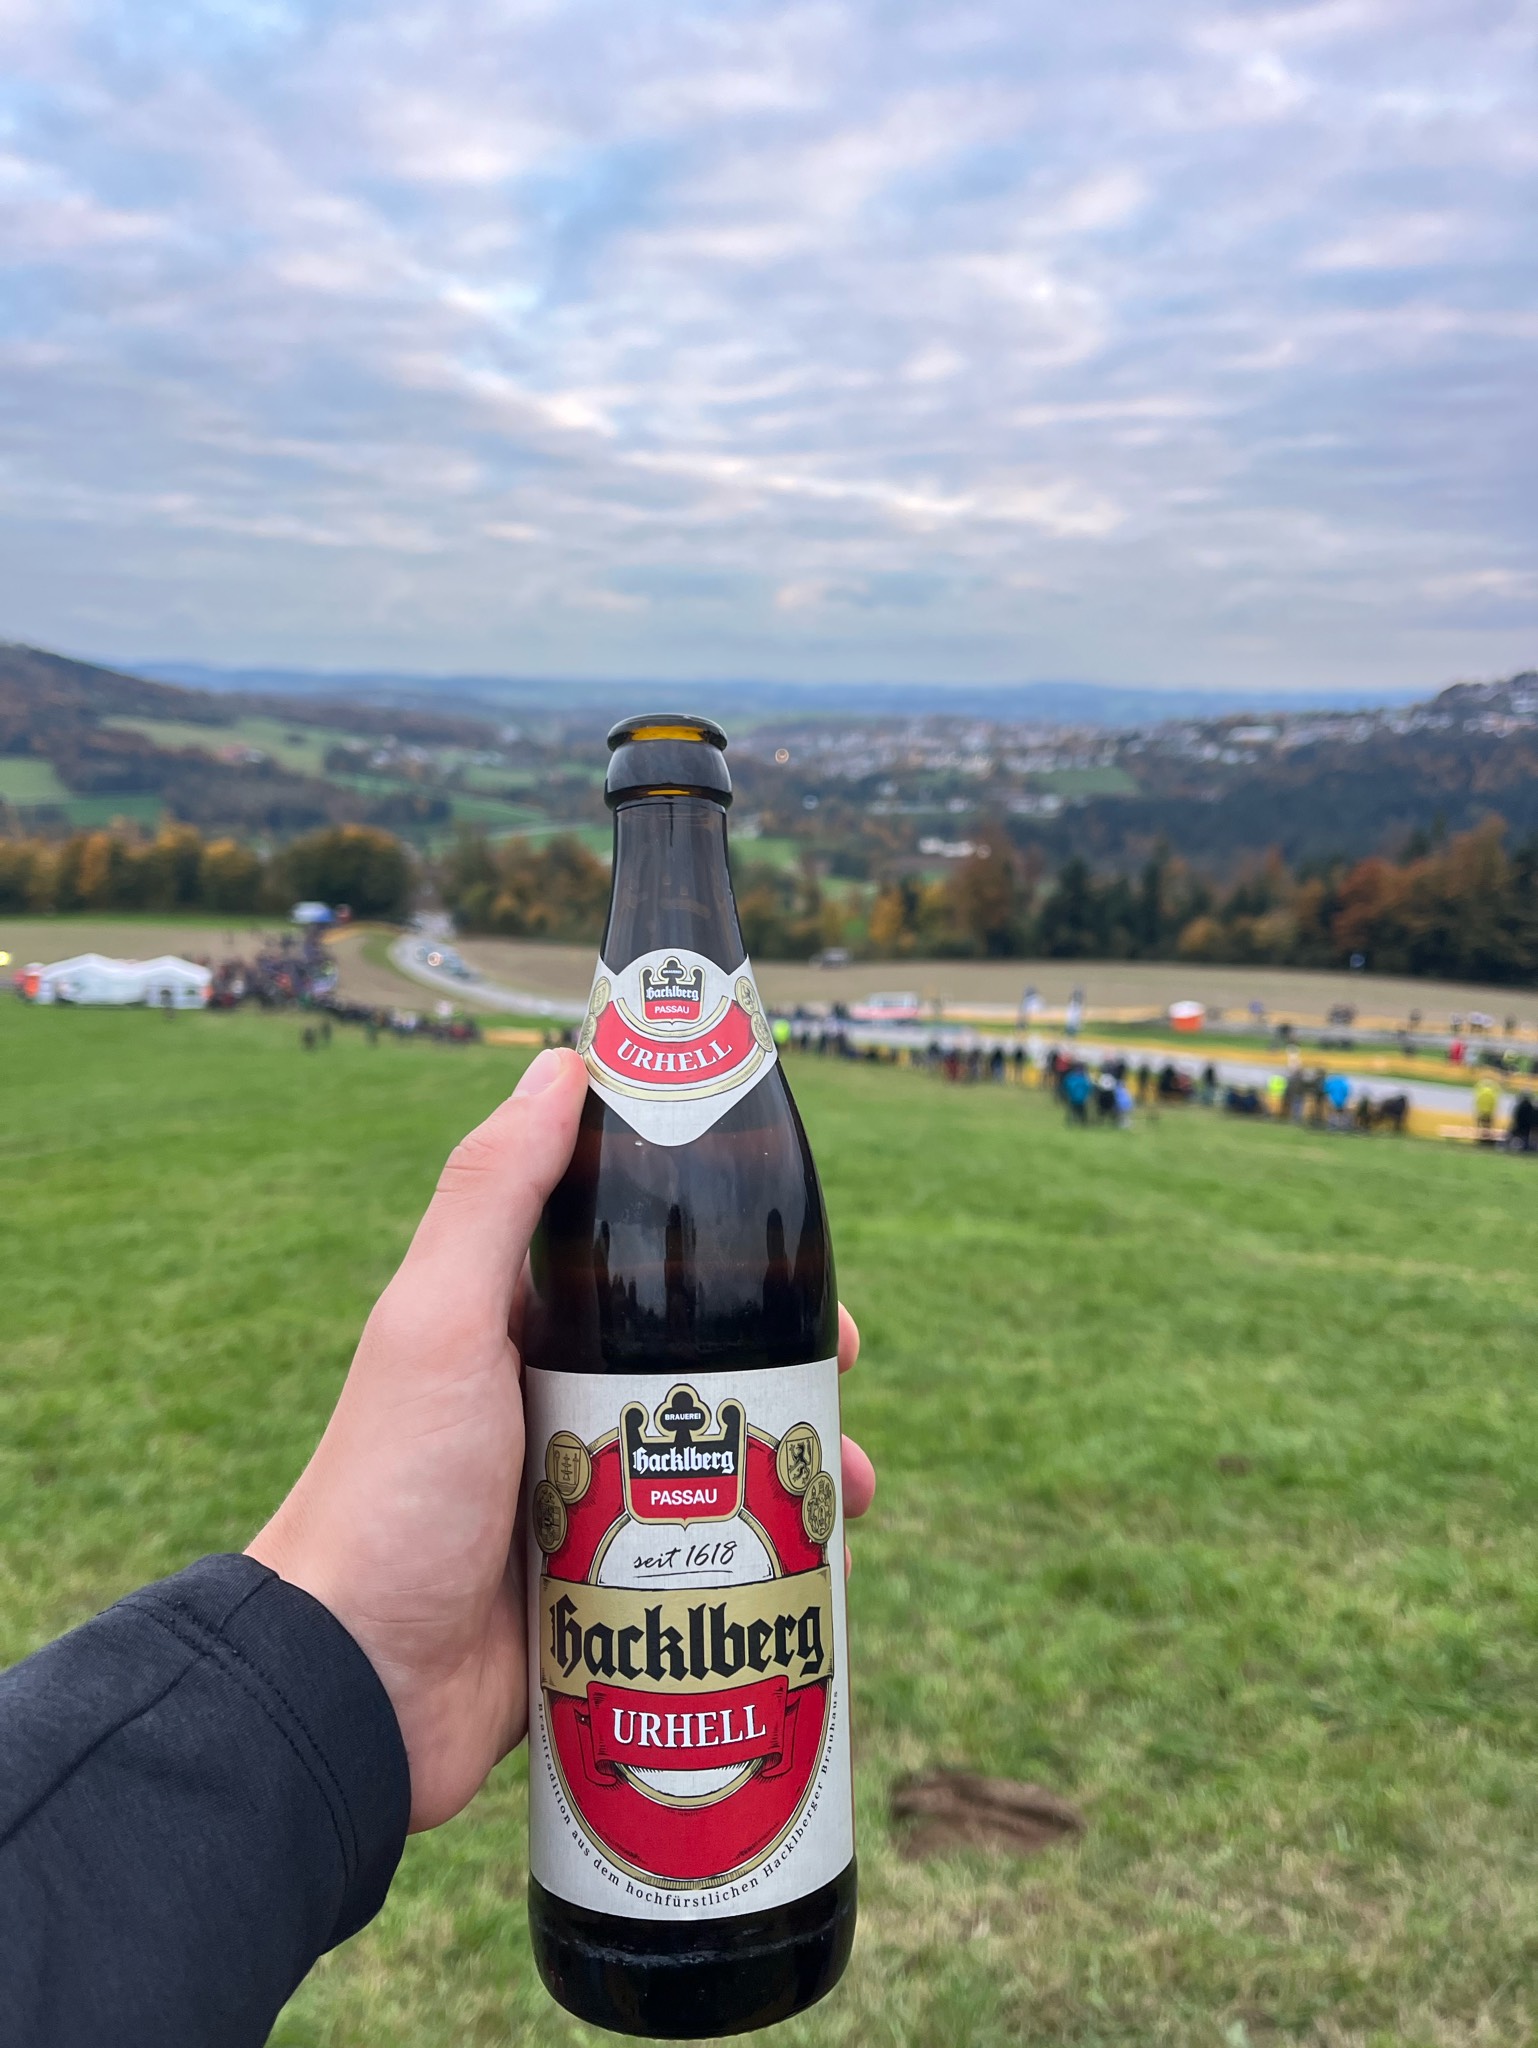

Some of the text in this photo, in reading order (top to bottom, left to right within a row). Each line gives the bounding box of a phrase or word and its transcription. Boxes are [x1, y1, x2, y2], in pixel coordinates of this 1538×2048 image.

[654, 1005, 690, 1014] PASSAU
[616, 1037, 733, 1072] URHELL
[664, 1412, 702, 1421] BRAUEREI
[650, 1488, 718, 1506] PASSAU
[633, 1540, 738, 1569] seit 1618
[612, 1703, 767, 1749] URHELL
[571, 1829, 590, 1857] aus
[593, 1858, 621, 1886] dem
[625, 1877, 759, 1908] hochfürstlichen
[762, 1782, 823, 1879] Hacklberger
[820, 1691, 838, 1775] Brauhaus
